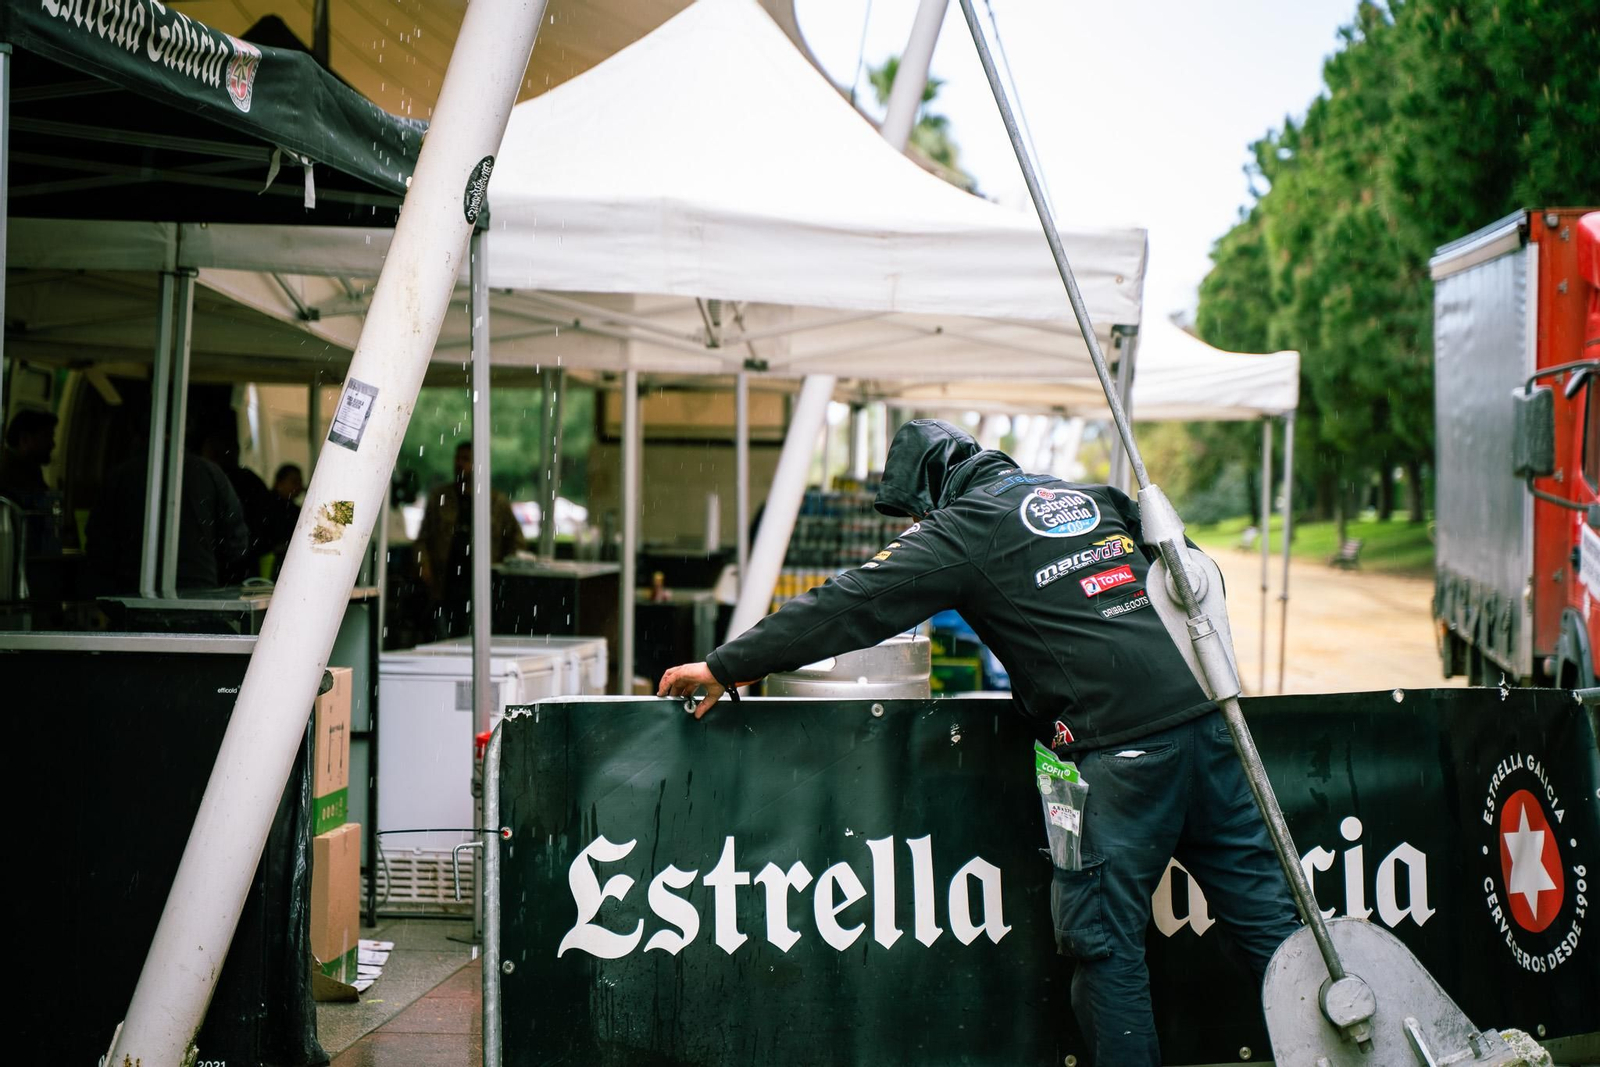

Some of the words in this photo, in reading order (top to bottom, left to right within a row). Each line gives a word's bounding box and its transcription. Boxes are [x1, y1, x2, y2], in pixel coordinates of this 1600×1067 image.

[41, 0, 146, 54] ella
[1030, 495, 1086, 517] Estrella
[1043, 506, 1092, 527] Galicia
[1097, 571, 1133, 586] TOTAL
[1482, 752, 1524, 826] ESTRELLA
[1526, 754, 1565, 824] GALICIA
[557, 834, 1013, 960] Estrella
[1151, 816, 1436, 938] acia
[1483, 876, 1547, 974] CERVECEROS
[1547, 920, 1582, 971] DESDE
[1573, 864, 1589, 919] 1906
